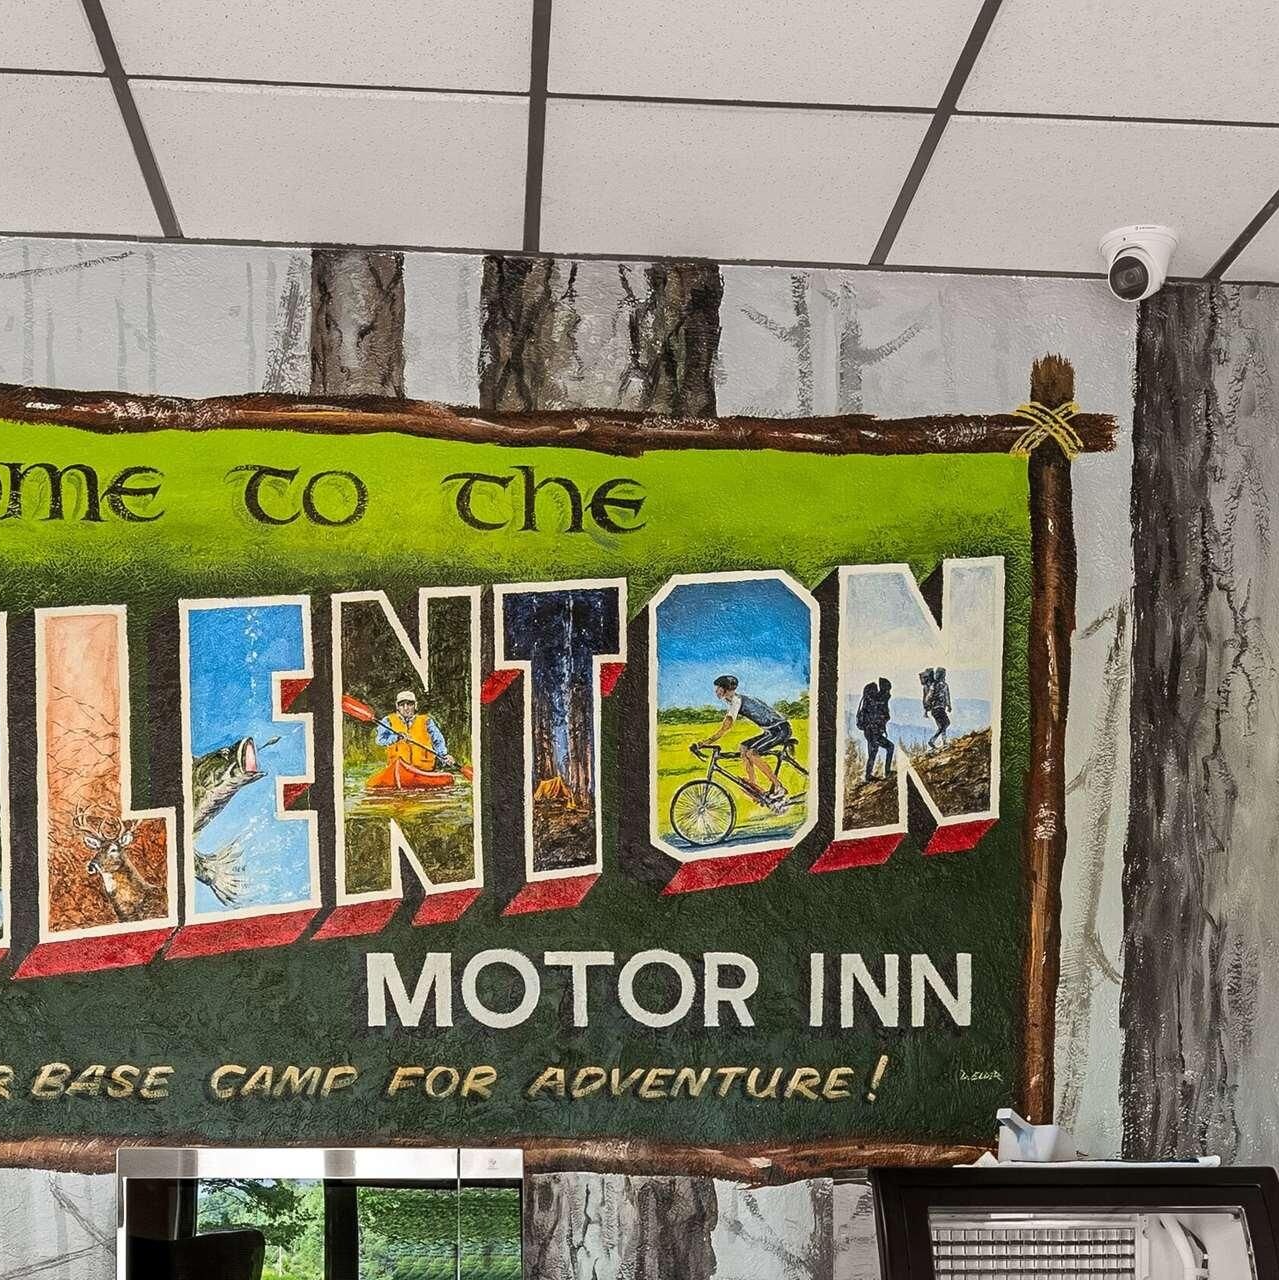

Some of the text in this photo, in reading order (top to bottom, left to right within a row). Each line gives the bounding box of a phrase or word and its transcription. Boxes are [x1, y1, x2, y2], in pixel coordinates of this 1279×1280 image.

[365, 947, 973, 1030] MOTOR INN
[32, 1061, 175, 1100] BASE
[210, 1063, 359, 1100] CAMP
[386, 1065, 497, 1100] FOR
[526, 1054, 889, 1105] ADVENTURE!
